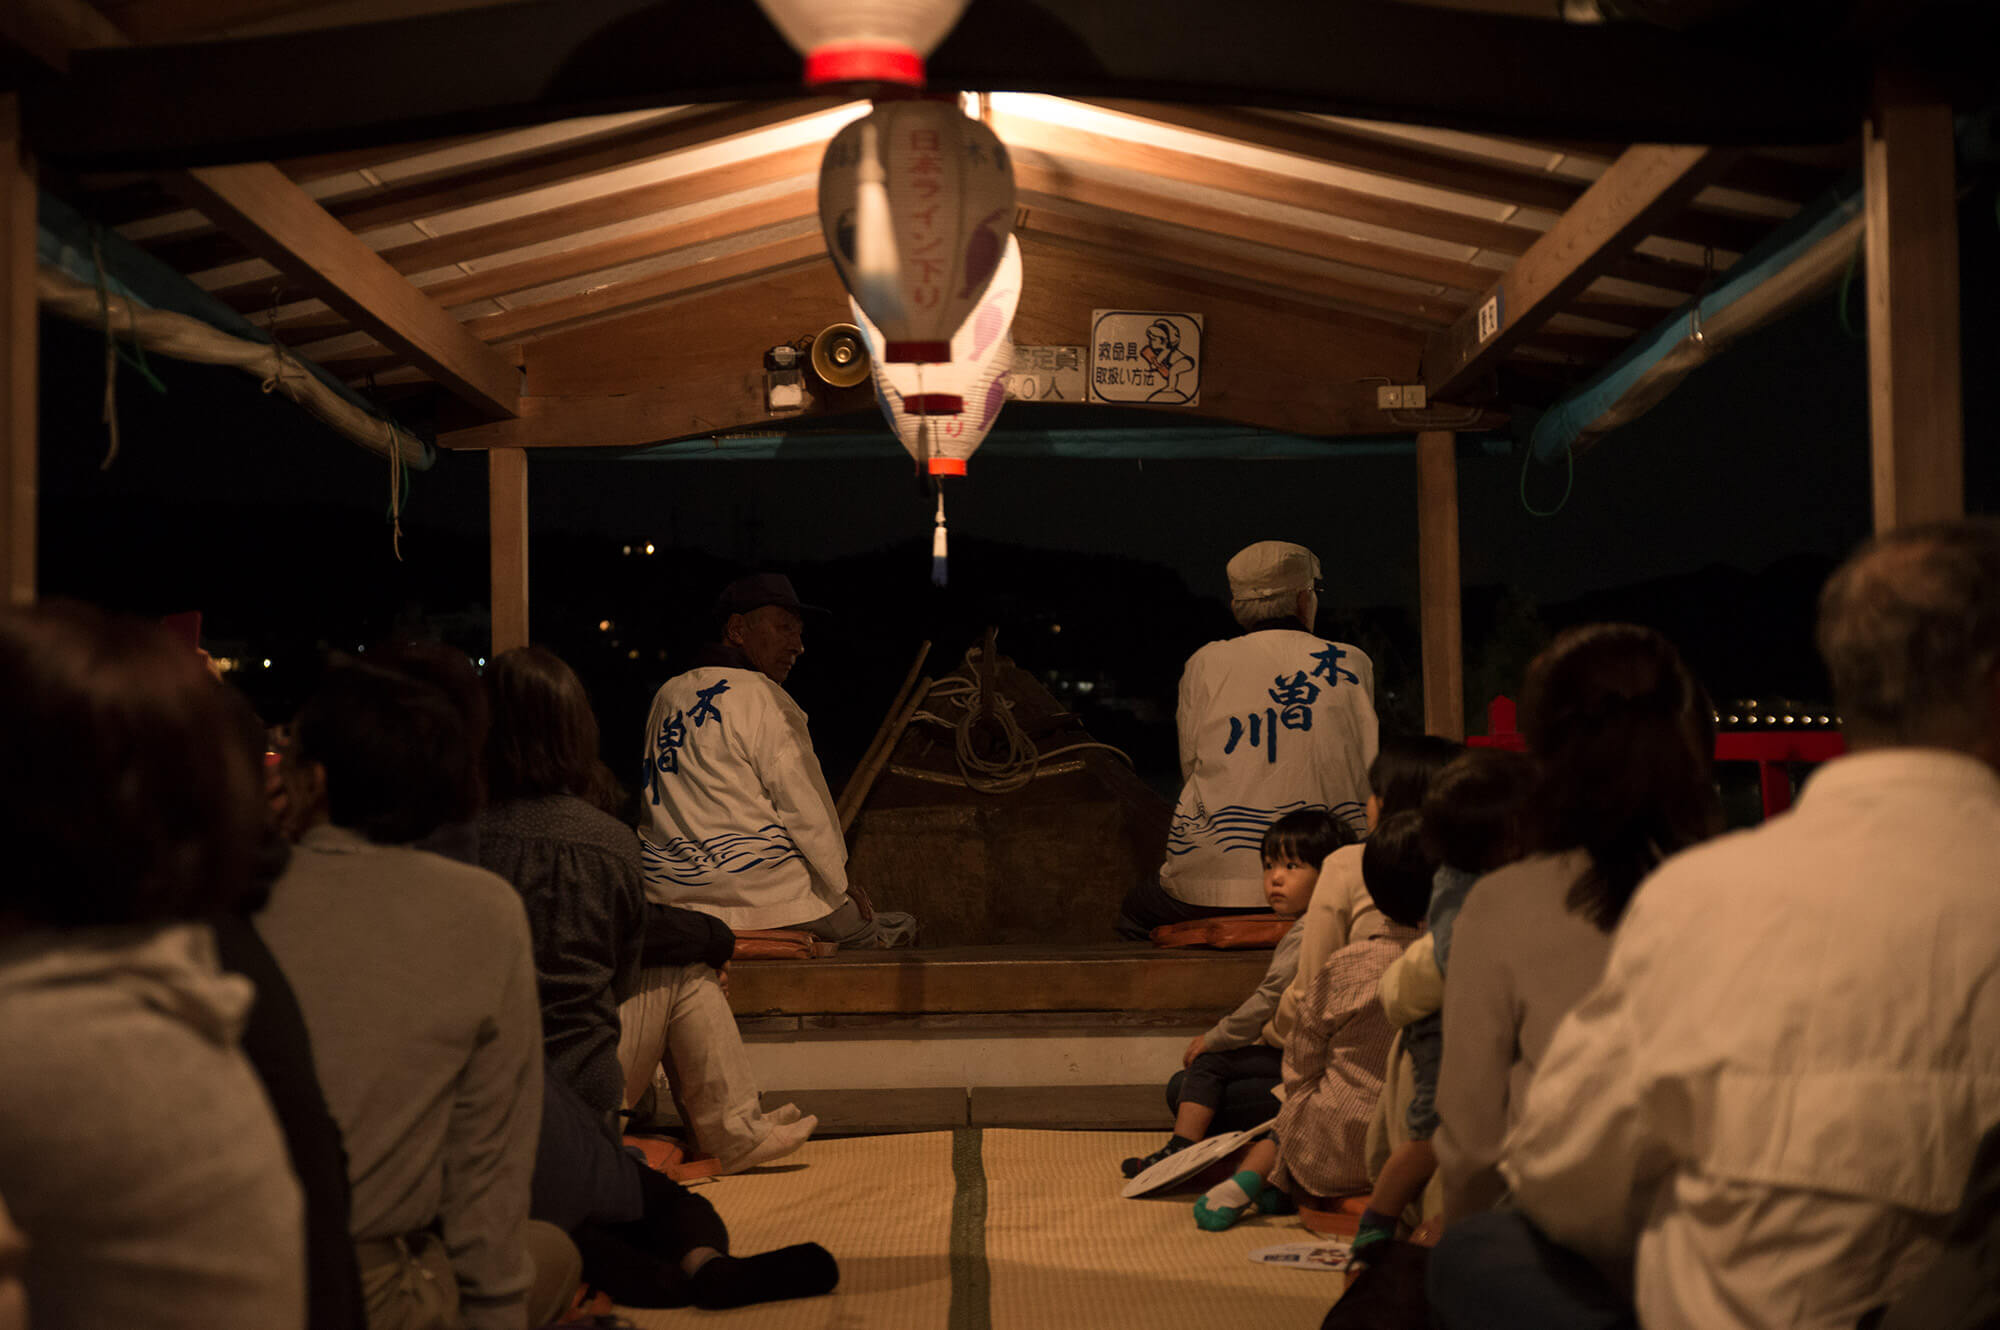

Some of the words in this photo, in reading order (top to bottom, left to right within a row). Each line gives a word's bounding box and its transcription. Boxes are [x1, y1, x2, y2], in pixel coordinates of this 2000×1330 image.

[911, 129, 945, 308] 日本ライン下り
[1095, 366, 1155, 387] 取扱い方法
[1098, 341, 1139, 362] 救命具
[1223, 642, 1359, 764] 木曽川
